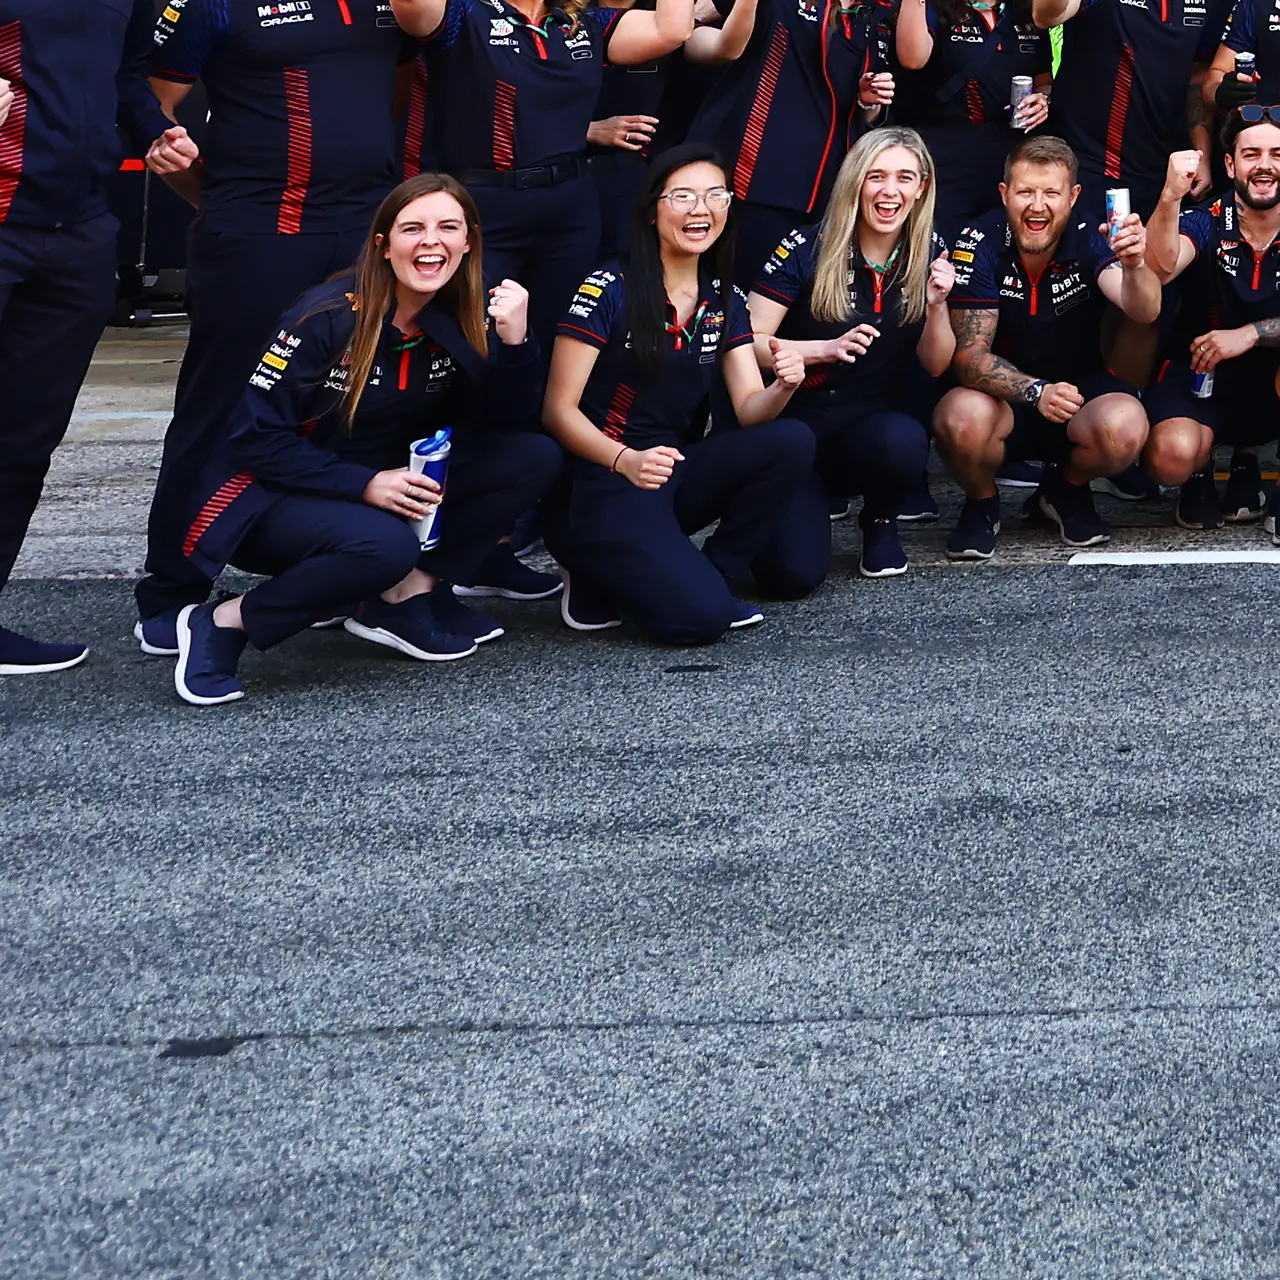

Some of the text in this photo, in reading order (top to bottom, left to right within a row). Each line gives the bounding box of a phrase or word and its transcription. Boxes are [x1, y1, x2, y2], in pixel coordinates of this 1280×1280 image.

[257, 2, 296, 17] Mobil
[260, 13, 314, 27] ORACLE
[955, 239, 978, 250] Claro
[1052, 273, 1081, 294] BYBIT
[1000, 289, 1024, 300] ORAC
[1052, 283, 1087, 304] HONDA
